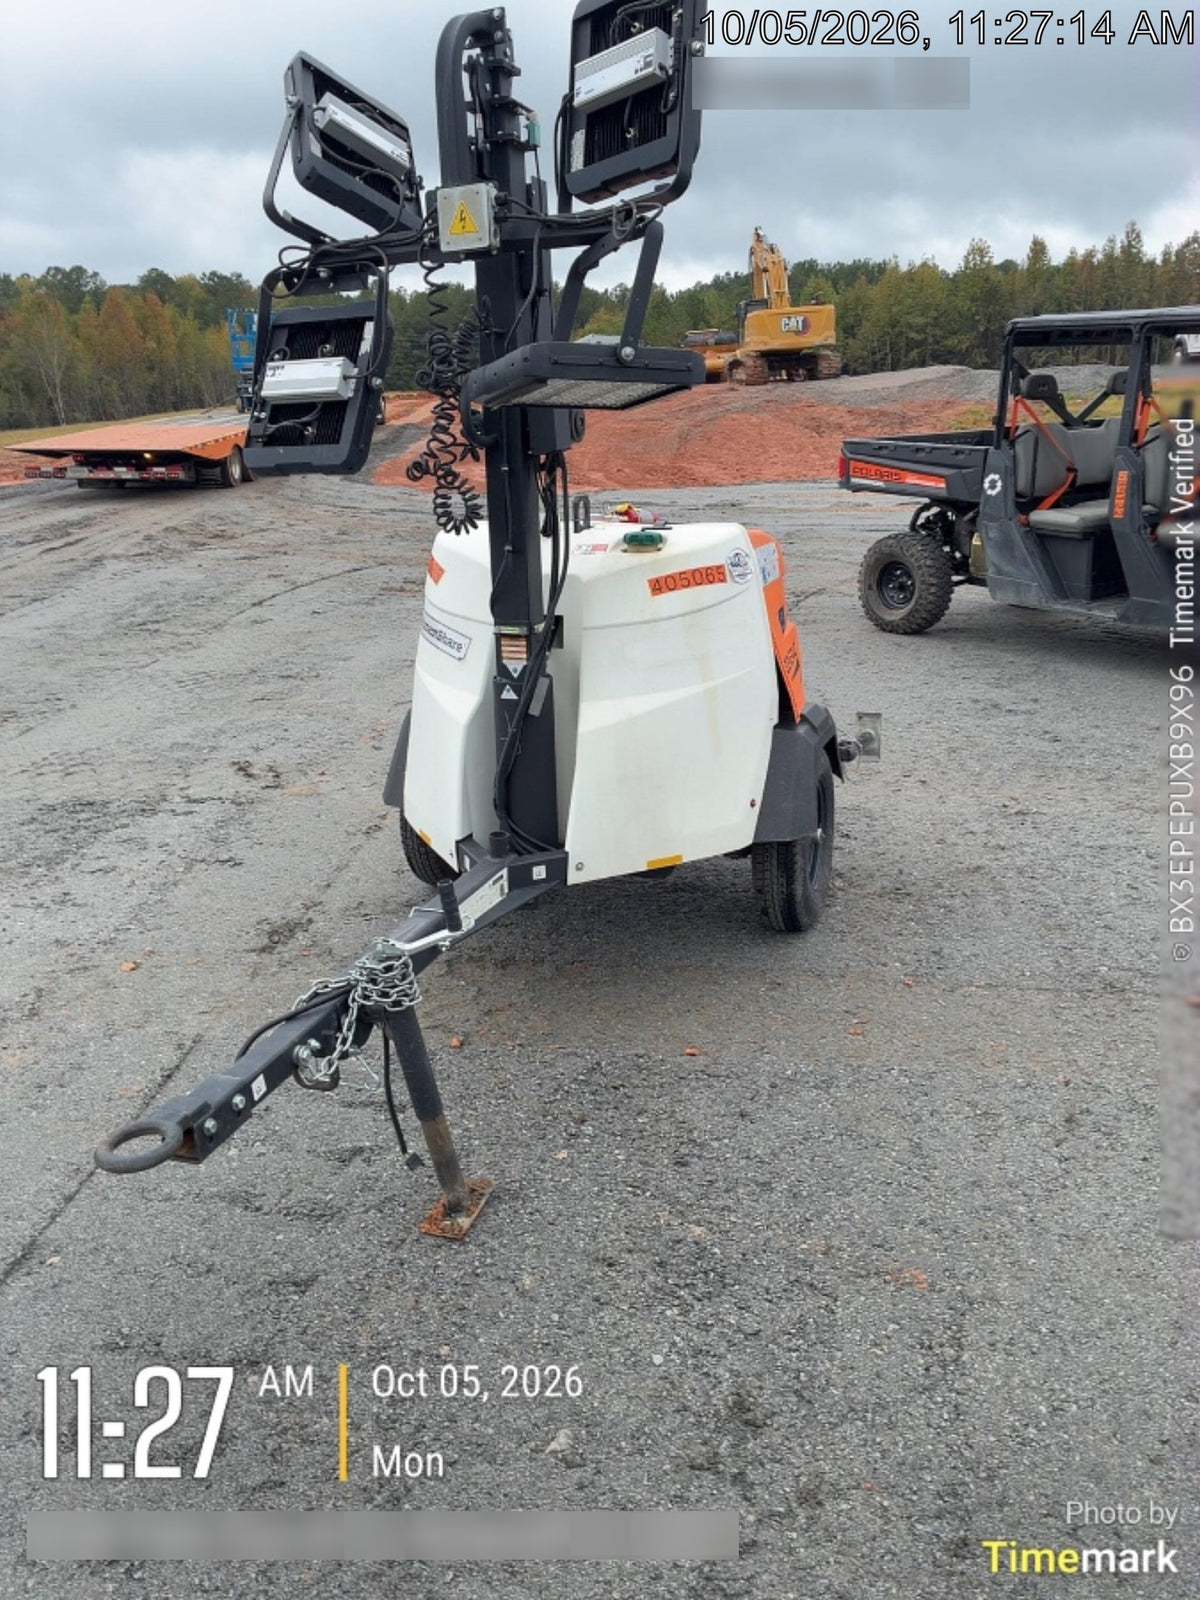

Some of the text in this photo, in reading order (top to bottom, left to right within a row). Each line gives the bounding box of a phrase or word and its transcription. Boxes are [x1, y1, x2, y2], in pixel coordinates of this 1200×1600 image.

[781, 315, 805, 332] CAT
[853, 466, 903, 481] POLARIS
[652, 565, 726, 592] 405065
